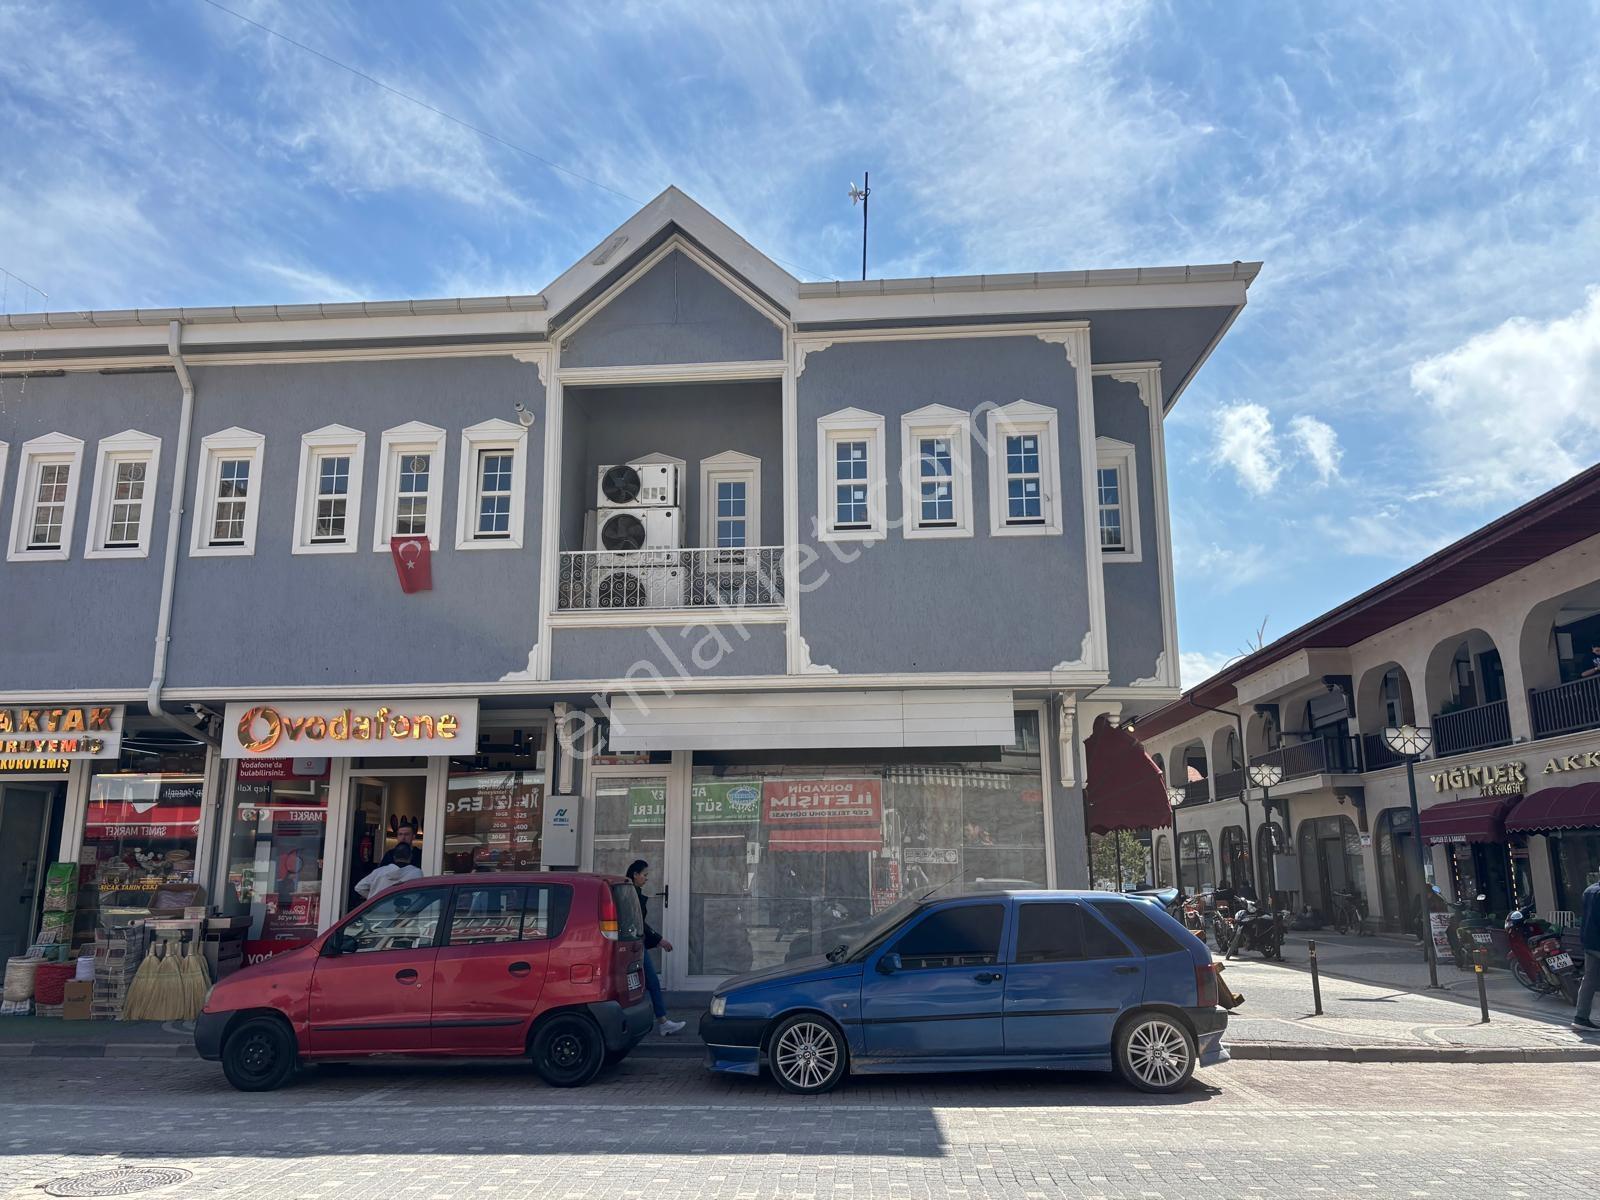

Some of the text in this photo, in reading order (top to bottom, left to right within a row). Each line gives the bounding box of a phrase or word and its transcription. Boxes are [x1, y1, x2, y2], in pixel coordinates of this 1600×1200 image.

[283, 706, 459, 741] vodafone
[0, 735, 104, 755] RUYEMİŞ
[240, 761, 283, 769] Vodafone'da
